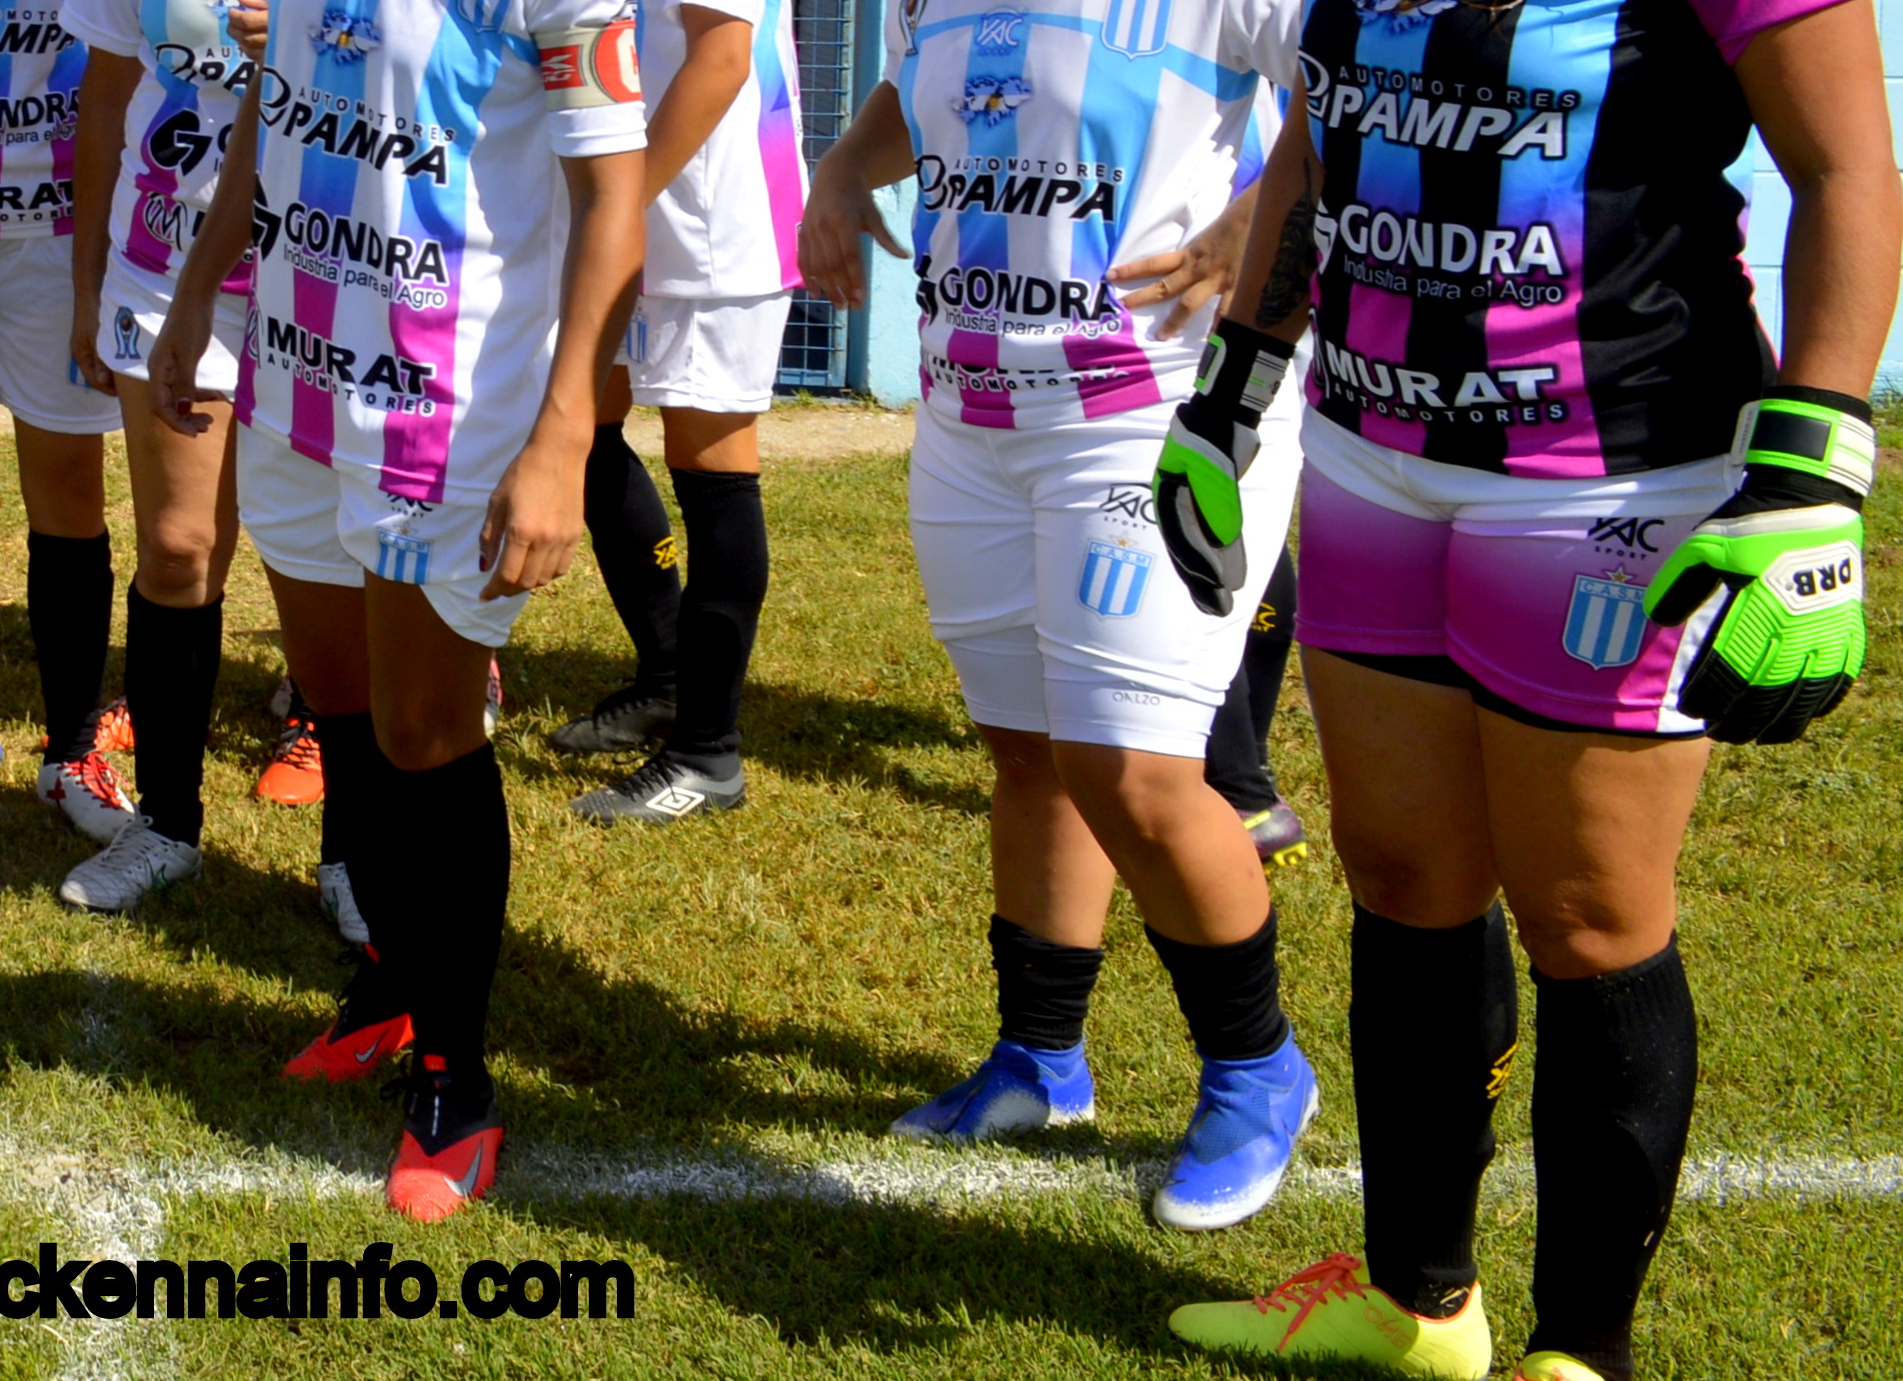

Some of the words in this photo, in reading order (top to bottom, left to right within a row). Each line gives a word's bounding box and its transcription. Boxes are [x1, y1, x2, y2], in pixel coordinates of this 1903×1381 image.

[300, 86, 455, 142] AUTOMOTORES
[1339, 65, 1578, 108] AUTOMOTORES
[5, 129, 40, 147] para
[283, 102, 447, 185] PAMPA
[1327, 83, 1564, 157] PAMPA
[948, 174, 1116, 222] PAMPA
[955, 157, 1124, 183] AUTOMOTORES
[284, 202, 448, 284] GONDRA
[1339, 204, 1564, 276] GONDRA
[284, 243, 338, 281] Industria
[343, 269, 381, 294] para
[396, 284, 446, 309] Agro
[939, 267, 1119, 321] GONDRA
[1417, 277, 1461, 301] para
[1471, 279, 1493, 298] el
[1500, 280, 1563, 307] Agro
[945, 309, 998, 333] Industria
[1002, 319, 1046, 338] para
[267, 316, 433, 396] MURAT
[1325, 339, 1555, 408] MURAT
[267, 354, 434, 415] AUTOMOTORES
[1333, 381, 1564, 423] AUTOMOTORES
